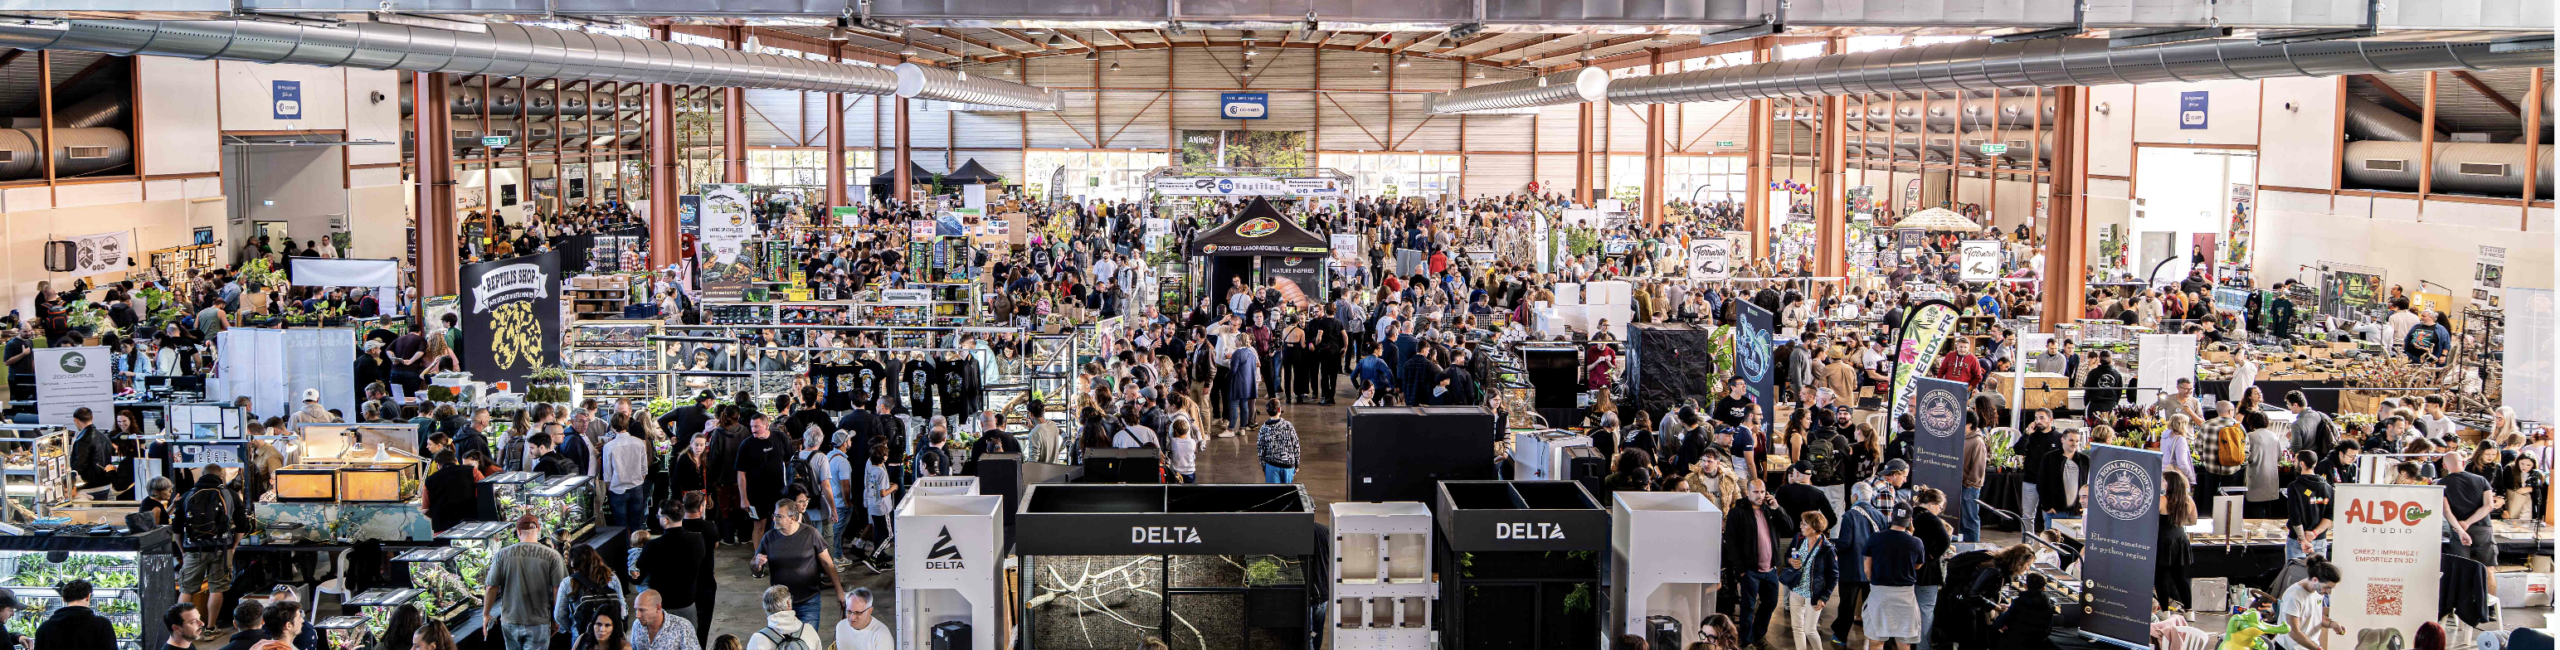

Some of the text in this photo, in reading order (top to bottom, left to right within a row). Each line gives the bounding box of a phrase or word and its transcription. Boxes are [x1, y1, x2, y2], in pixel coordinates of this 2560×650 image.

[485, 268, 536, 292] REPTILIS SHOP
[2101, 462, 2150, 486] ROYAL MUTATION
[2345, 498, 2424, 526] ALDO
[1131, 526, 1202, 543] DELTA
[1496, 522, 1566, 539] DELTA
[2090, 531, 2151, 551] Éleveur amateur
[2099, 546, 2124, 557] python
[2125, 552, 2147, 560] regius
[925, 561, 965, 569] DELTA
